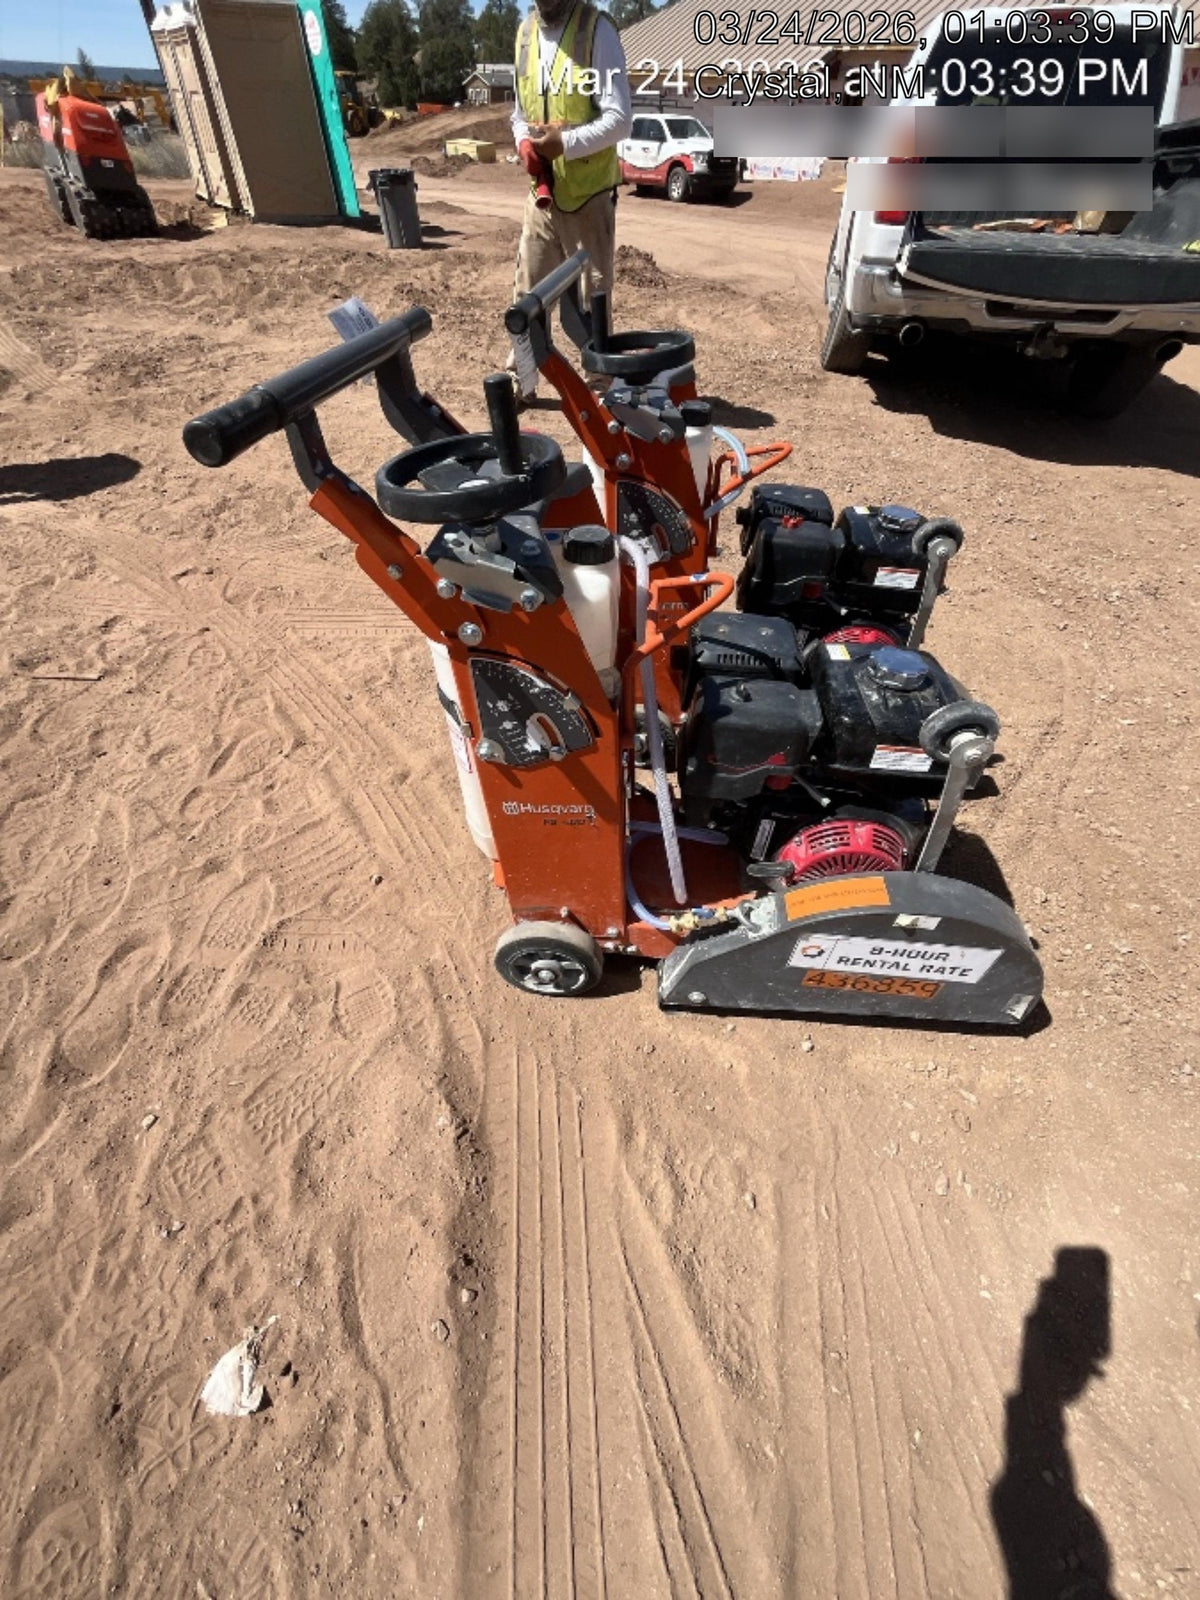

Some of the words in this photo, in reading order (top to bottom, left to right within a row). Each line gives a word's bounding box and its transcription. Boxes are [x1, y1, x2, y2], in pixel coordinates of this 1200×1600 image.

[869, 945, 950, 962] 8-HOUR
[836, 956, 911, 973] RENTAL
[919, 964, 974, 978] RATE
[805, 971, 942, 999] 436859
